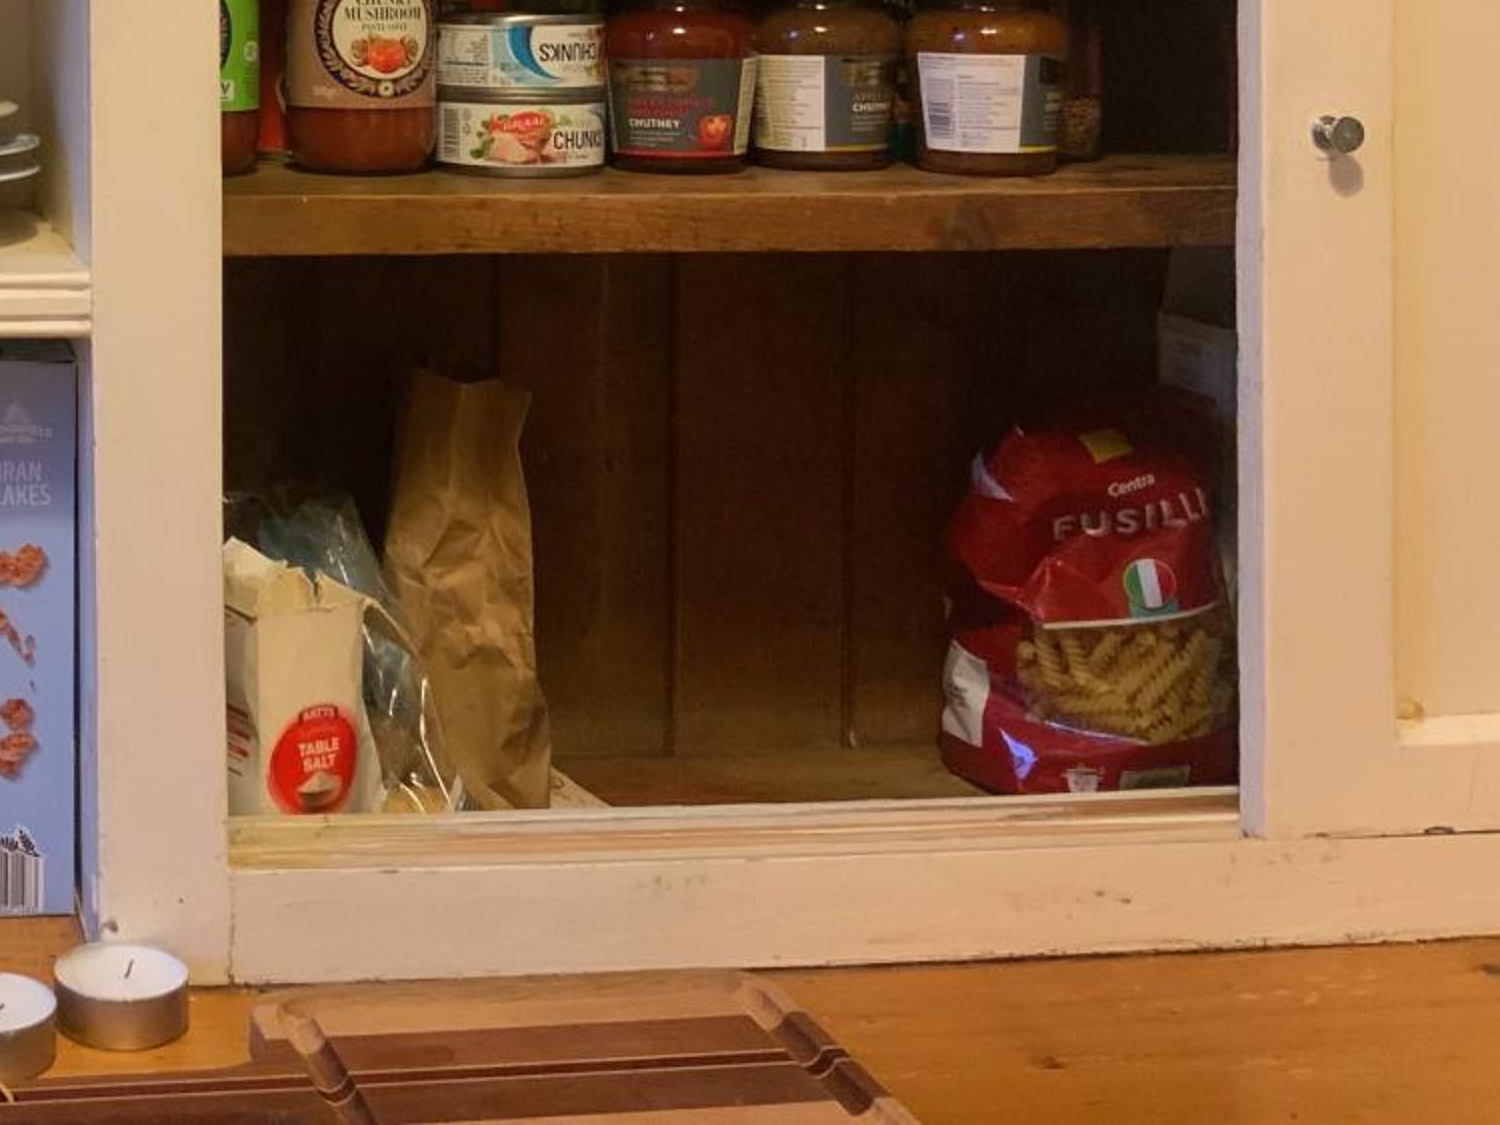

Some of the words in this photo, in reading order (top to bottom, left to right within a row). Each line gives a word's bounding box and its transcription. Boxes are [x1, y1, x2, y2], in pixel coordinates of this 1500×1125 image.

[344, 6, 421, 21] MUSHROOM
[539, 42, 597, 62] CHUNKS
[627, 117, 681, 130] CHUTNEY
[1107, 473, 1156, 498] Centra
[1052, 486, 1208, 541] FUSILLI
[297, 736, 341, 758] TABLE
[302, 752, 337, 773] SALT
